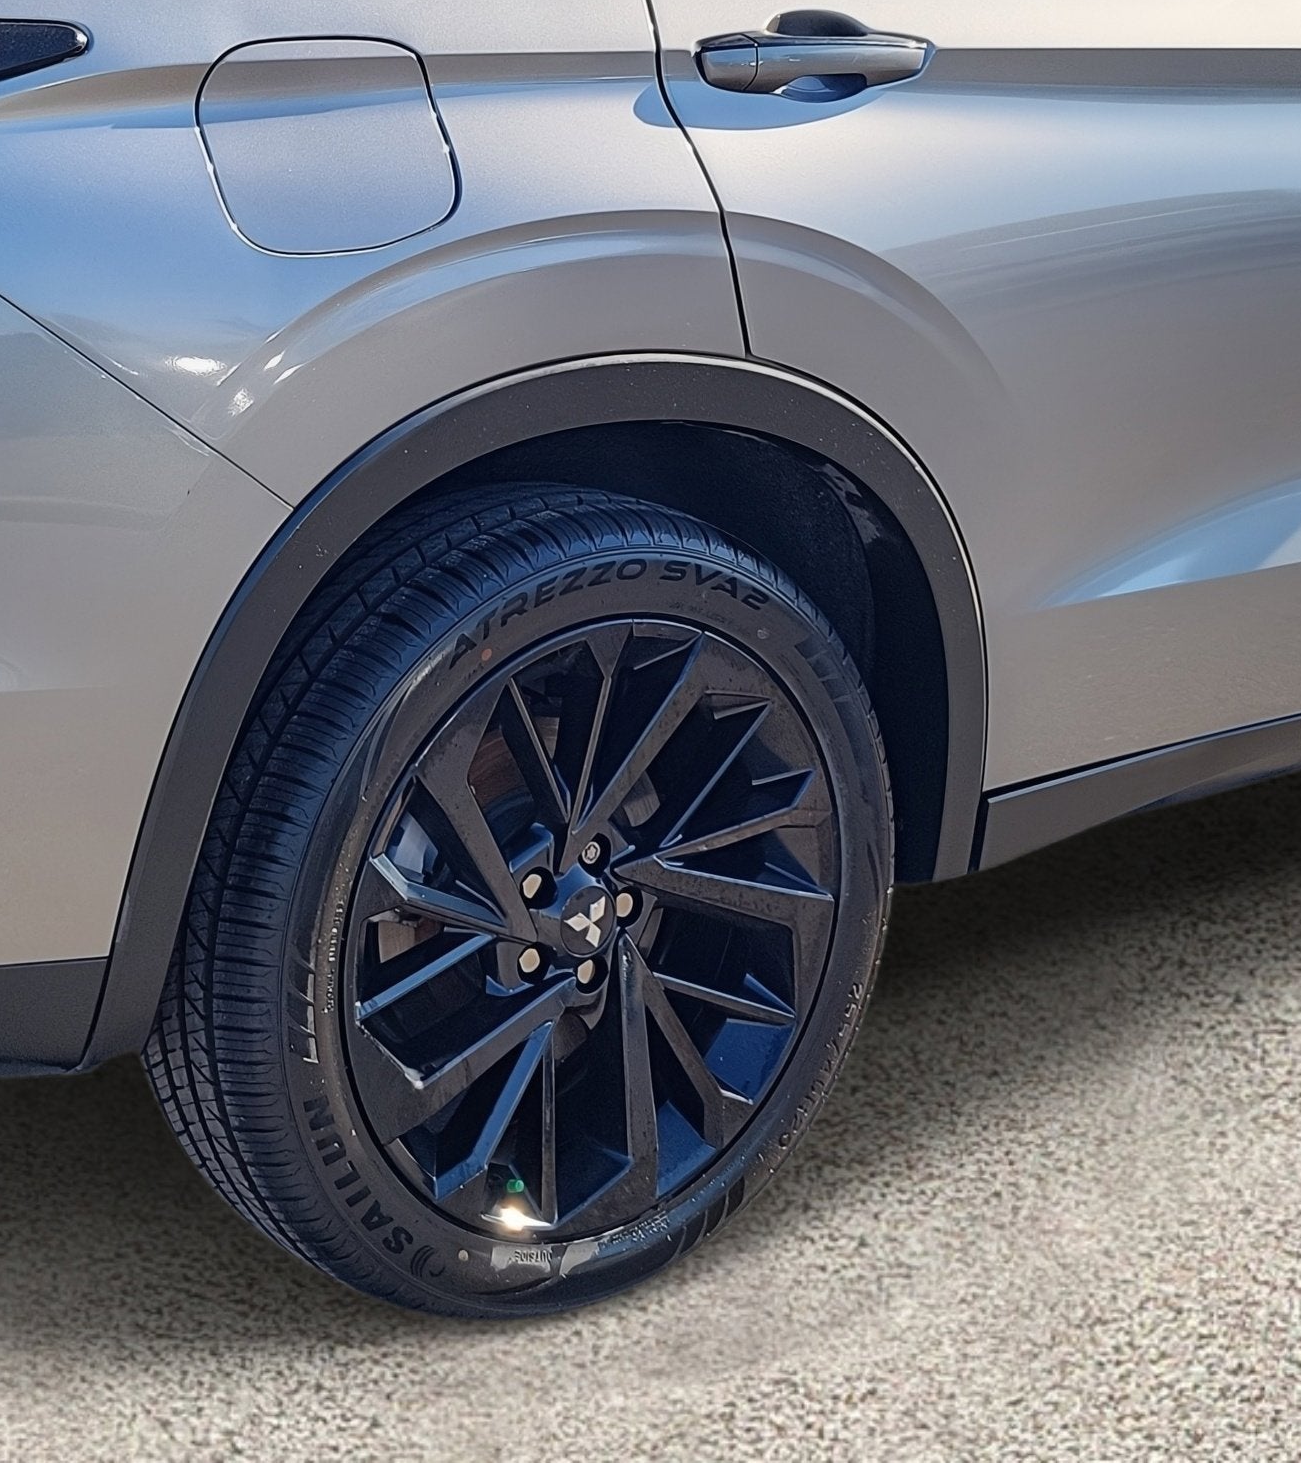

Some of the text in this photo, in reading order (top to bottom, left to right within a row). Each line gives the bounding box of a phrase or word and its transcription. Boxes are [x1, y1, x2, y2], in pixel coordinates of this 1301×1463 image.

[449, 558, 771, 669] ATREZZO SVA2
[303, 1094, 414, 1255] SAILUN
